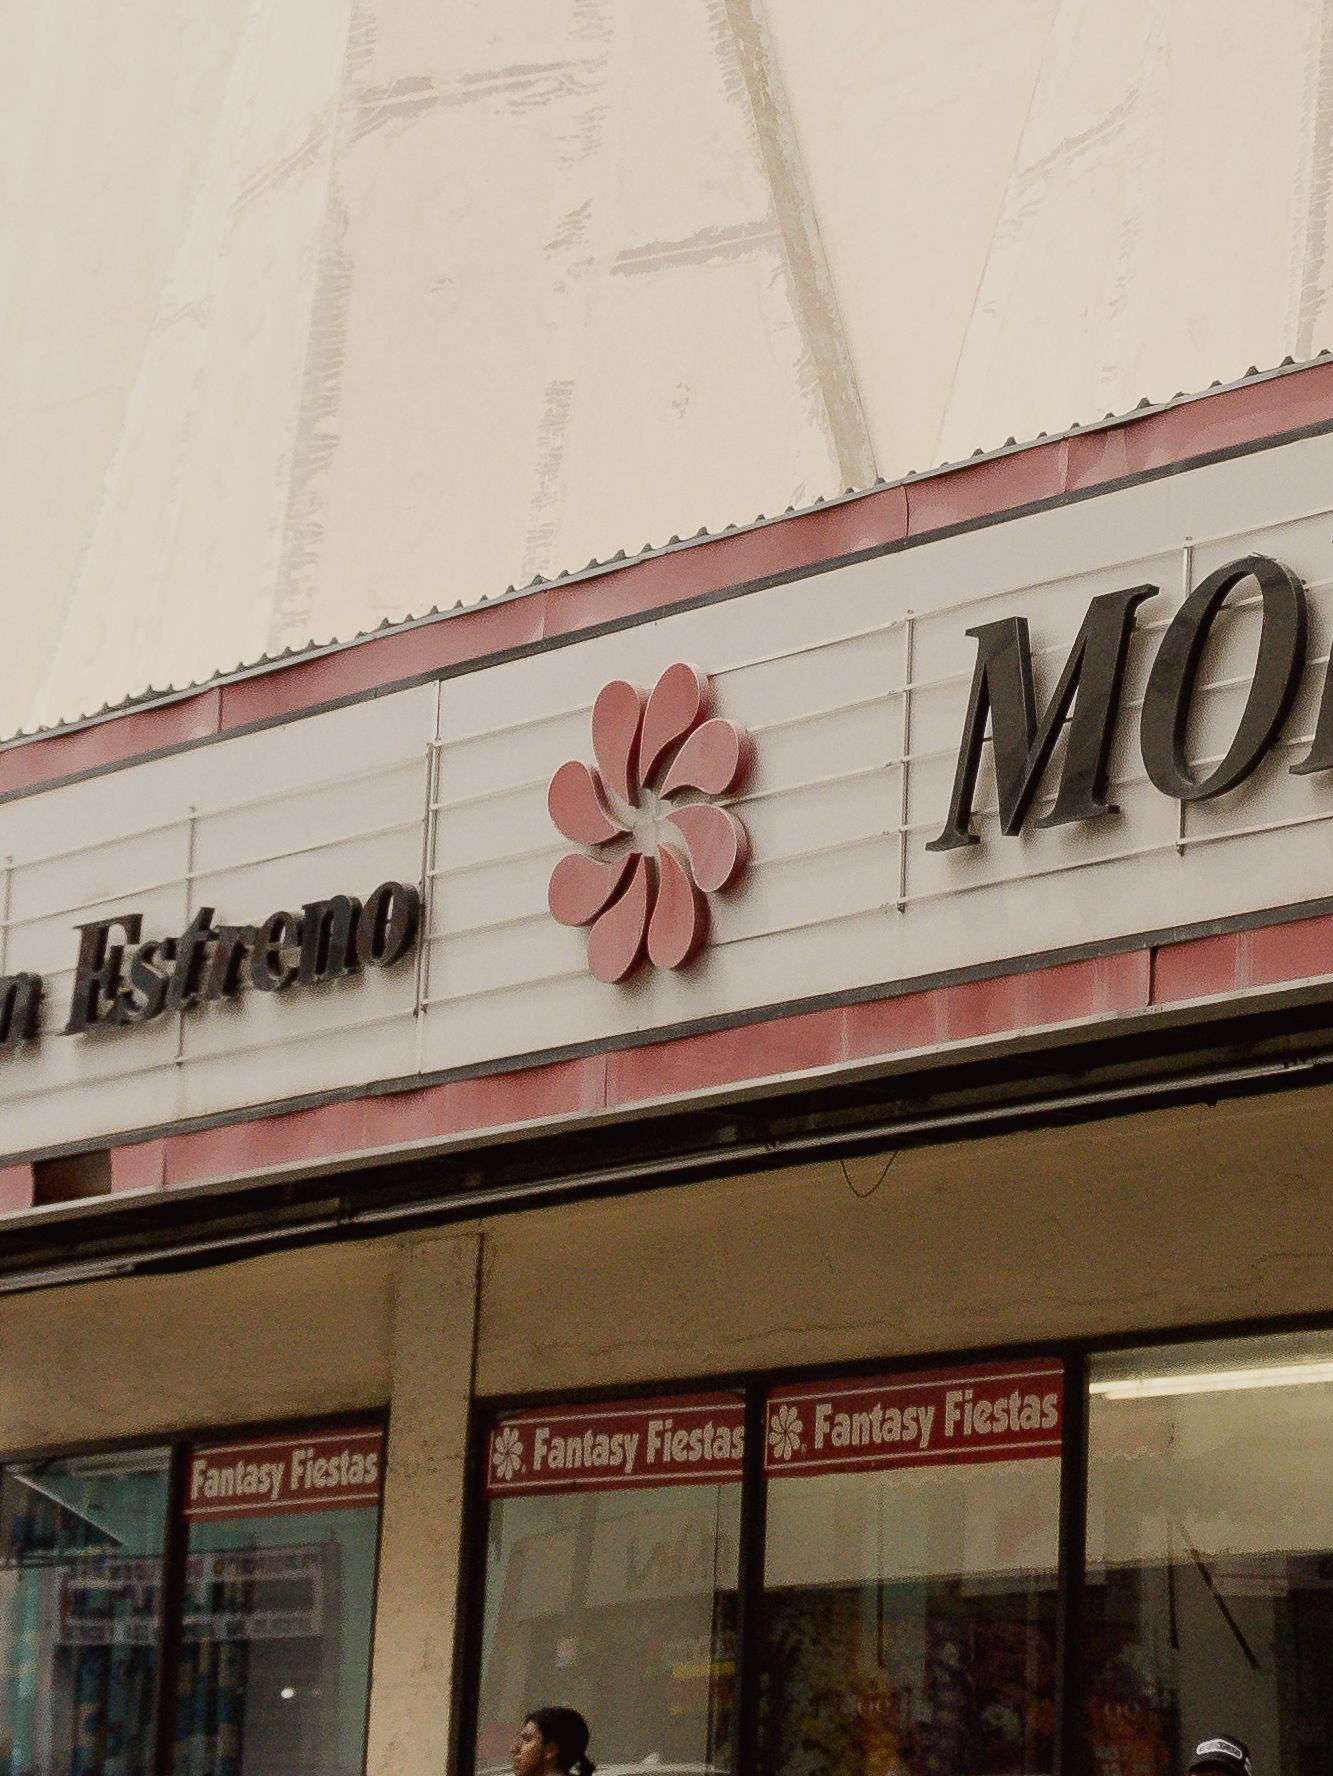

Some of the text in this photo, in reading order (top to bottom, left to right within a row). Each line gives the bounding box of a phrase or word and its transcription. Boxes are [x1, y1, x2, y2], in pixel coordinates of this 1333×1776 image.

[61, 881, 420, 1036] Estreno
[532, 1418, 745, 1474] Fantasy Fiestas
[814, 1389, 1059, 1449] Fantasy Fiestas
[190, 1447, 378, 1501] Fantasy Fiestas
